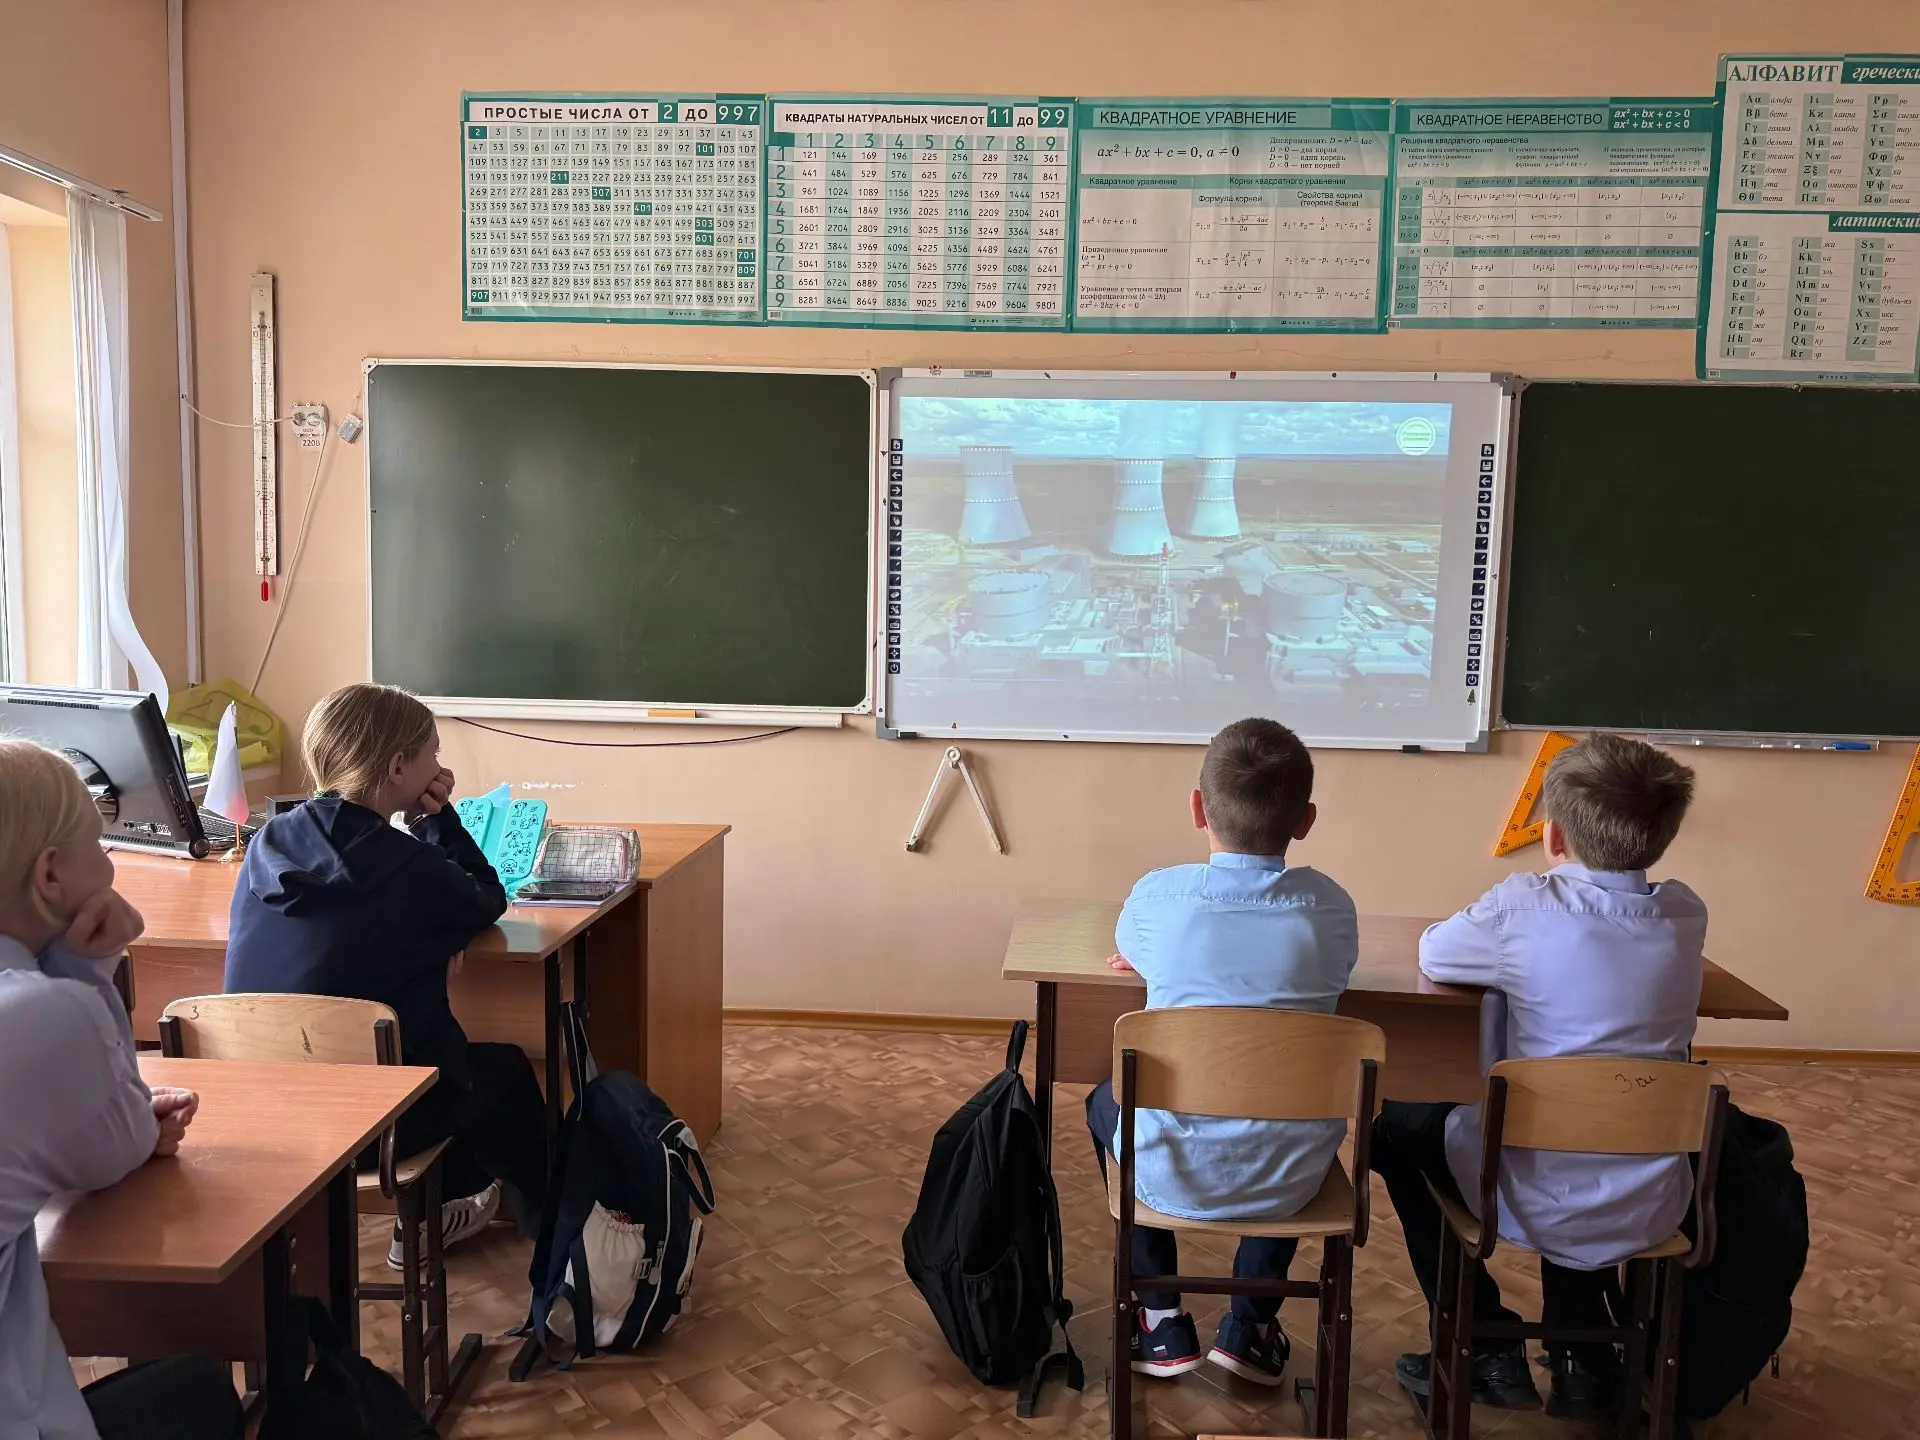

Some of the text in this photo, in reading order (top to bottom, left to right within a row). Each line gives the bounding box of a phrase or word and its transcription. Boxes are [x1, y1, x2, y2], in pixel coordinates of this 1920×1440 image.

[1728, 64, 1839, 82] АЛФАВИТ
[485, 104, 757, 122] ПРОСТЫЕ ЧИСЛА ОТ 2 ДО 997
[786, 108, 1065, 127] КВАДРАТЫ НАТУРАЛЬНЫХ ЧИСЕЛ ОТ 11 ДО 99
[1100, 111, 1297, 127] КВАДРАТНОЕ УРАВНЕНИЕ
[1684, 109, 1690, 118] 0
[1417, 113, 1603, 127] КВАДРАТНОЕ НЕРАВЕНСТВО
[1684, 119, 1690, 128] 0
[475, 128, 480, 136] 2
[496, 128, 501, 136] 3
[517, 128, 522, 136] 5
[538, 129, 542, 137] 7
[576, 129, 586, 137] 13
[596, 128, 606, 136] 17
[617, 129, 628, 137] 19
[637, 129, 648, 137] 23
[658, 129, 669, 137] 29
[679, 129, 689, 137] 31
[700, 129, 711, 138] 37
[721, 130, 731, 138] 41
[742, 130, 753, 138] 43
[806, 134, 1056, 150] 1 2 3 4 5 6 7 8 9
[1135, 147, 1150, 157] bx
[1167, 149, 1174, 157] c
[1232, 145, 1239, 156] 0
[1229, 177, 1253, 186] Корни
[472, 291, 754, 304] 907 911 919 929 937 941 947 953 967 971 977 983 991 997
[775, 293, 785, 306] 9
